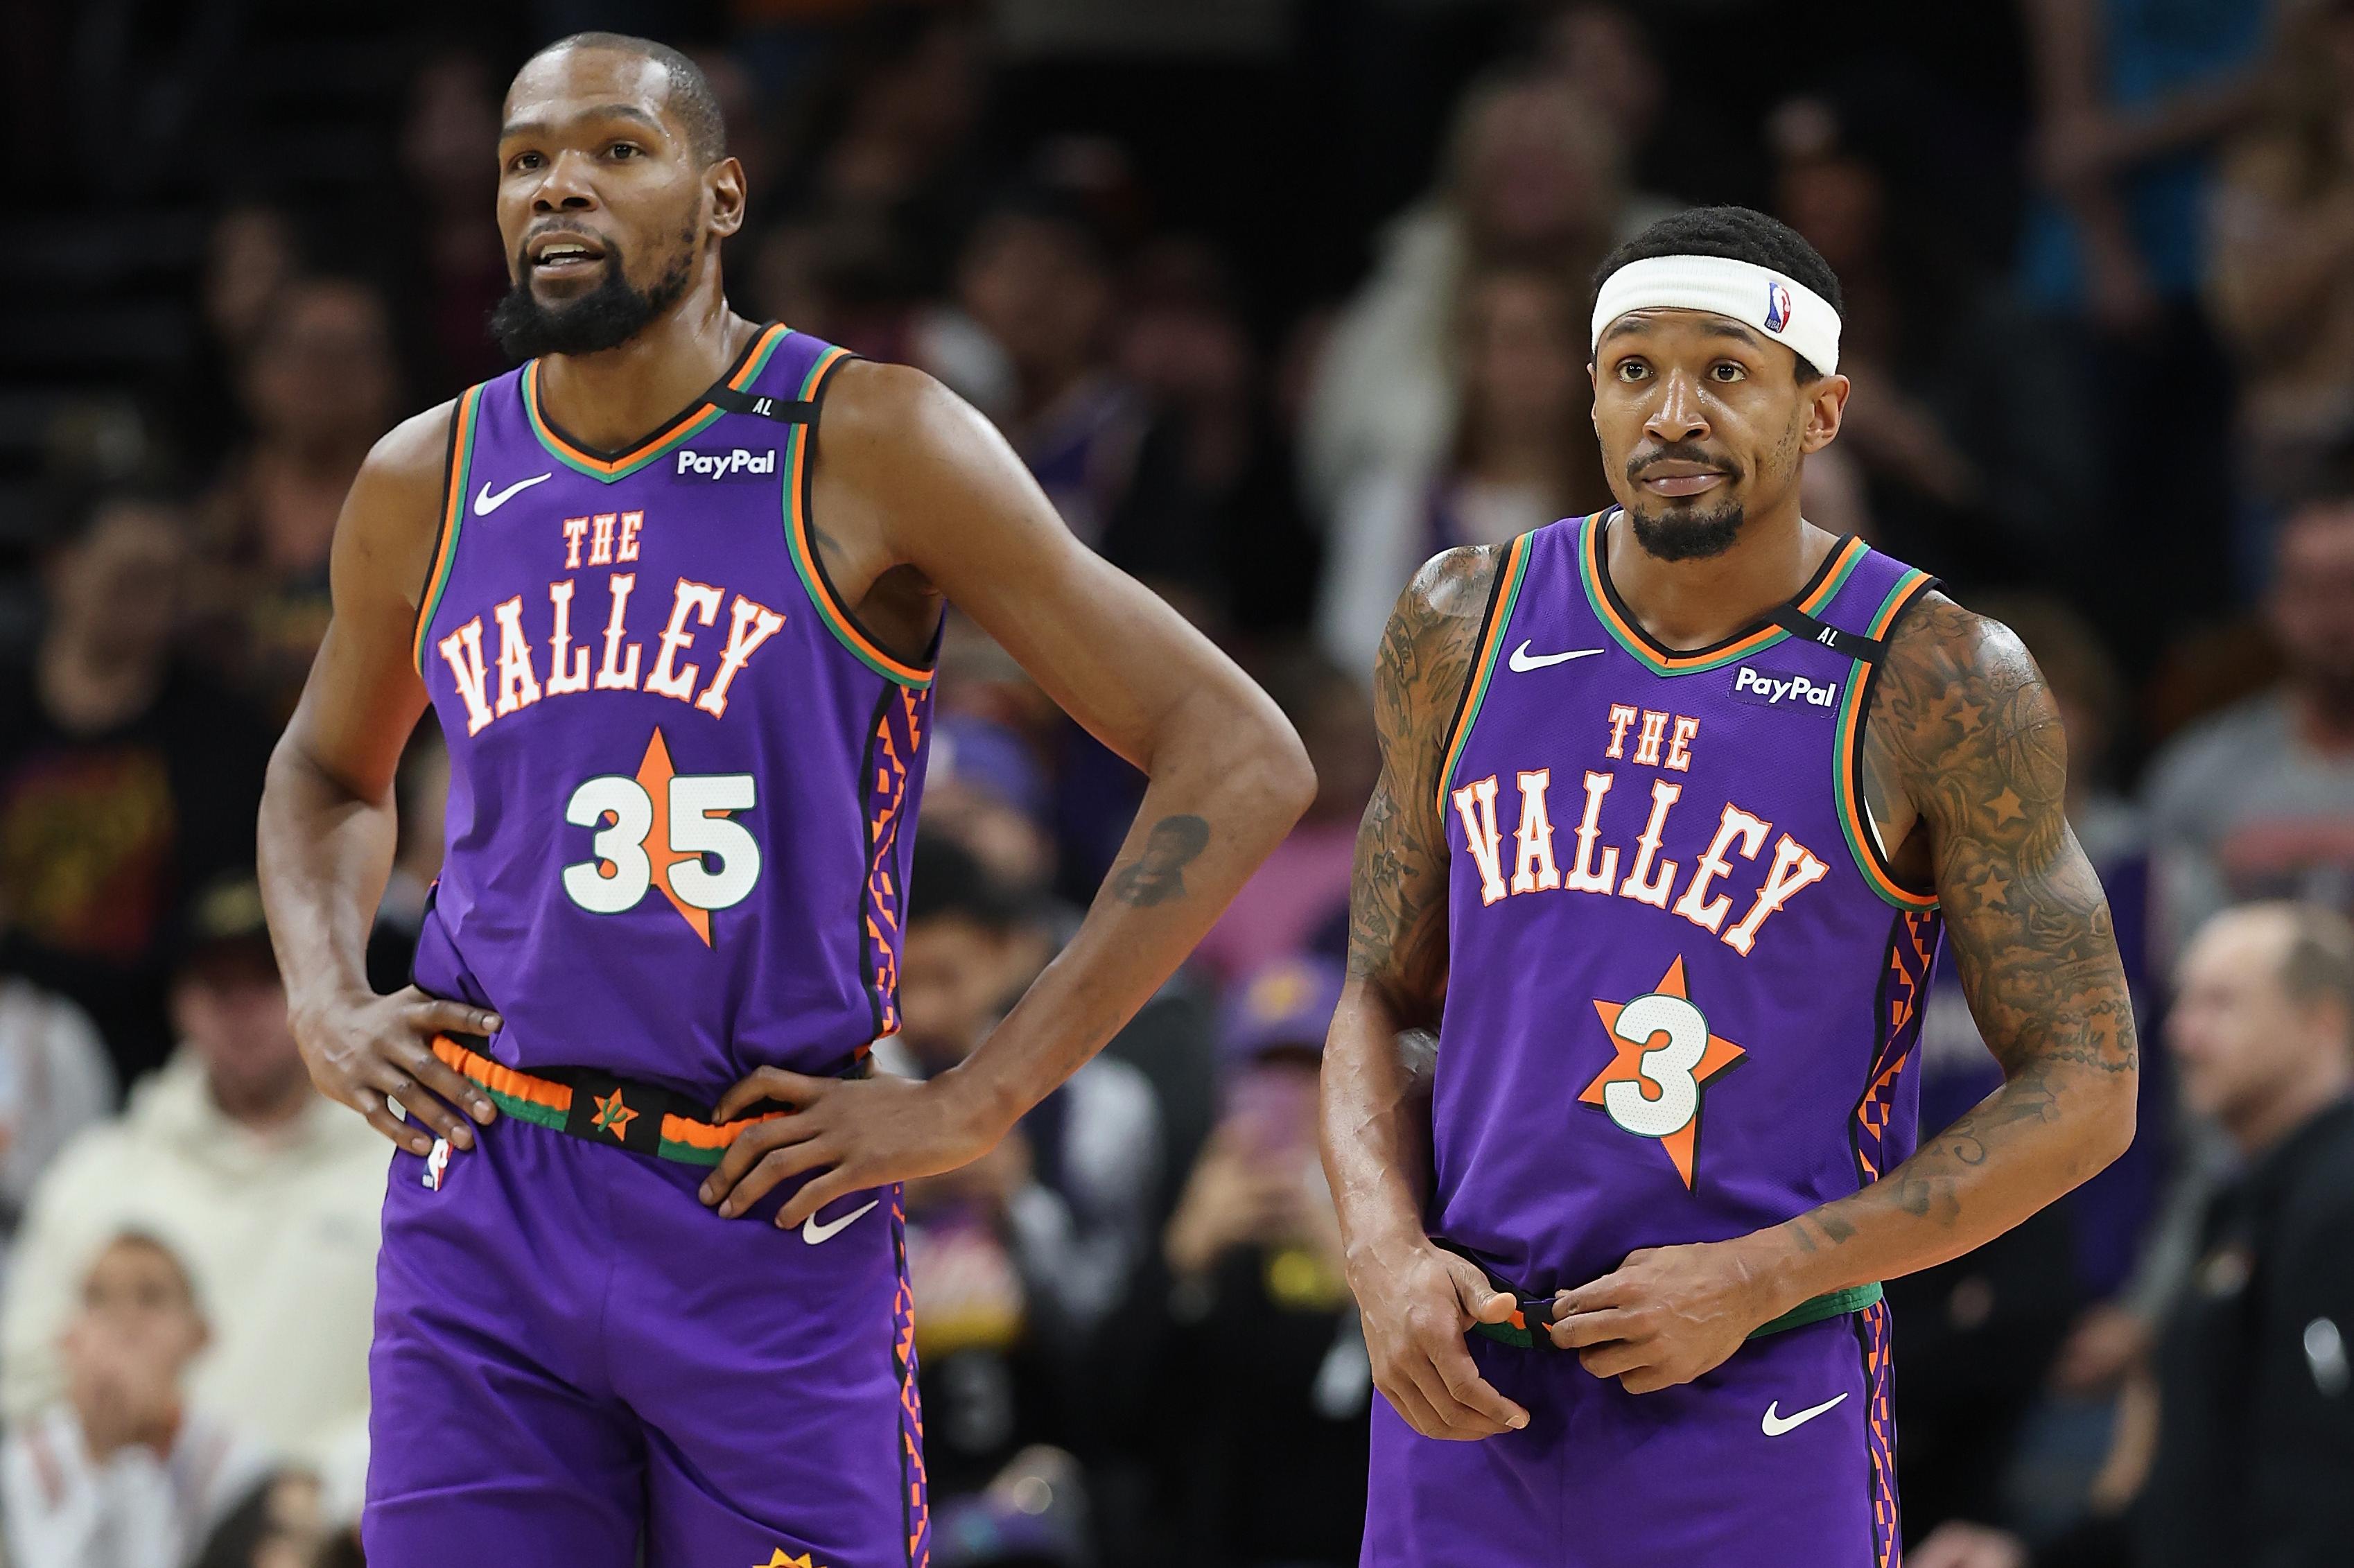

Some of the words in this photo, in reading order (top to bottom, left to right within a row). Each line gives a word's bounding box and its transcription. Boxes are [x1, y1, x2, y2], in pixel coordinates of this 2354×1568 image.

[752, 397, 773, 416] AL
[677, 448, 775, 480] PayPal
[563, 510, 644, 568] THE
[437, 573, 787, 738] VALLEY
[1817, 627, 1838, 647] AL
[1735, 666, 1836, 707] PayPal
[1605, 704, 1700, 773] THE
[561, 774, 762, 914] 35
[1451, 768, 1830, 957] VALLEY
[1603, 992, 1710, 1138] 3
